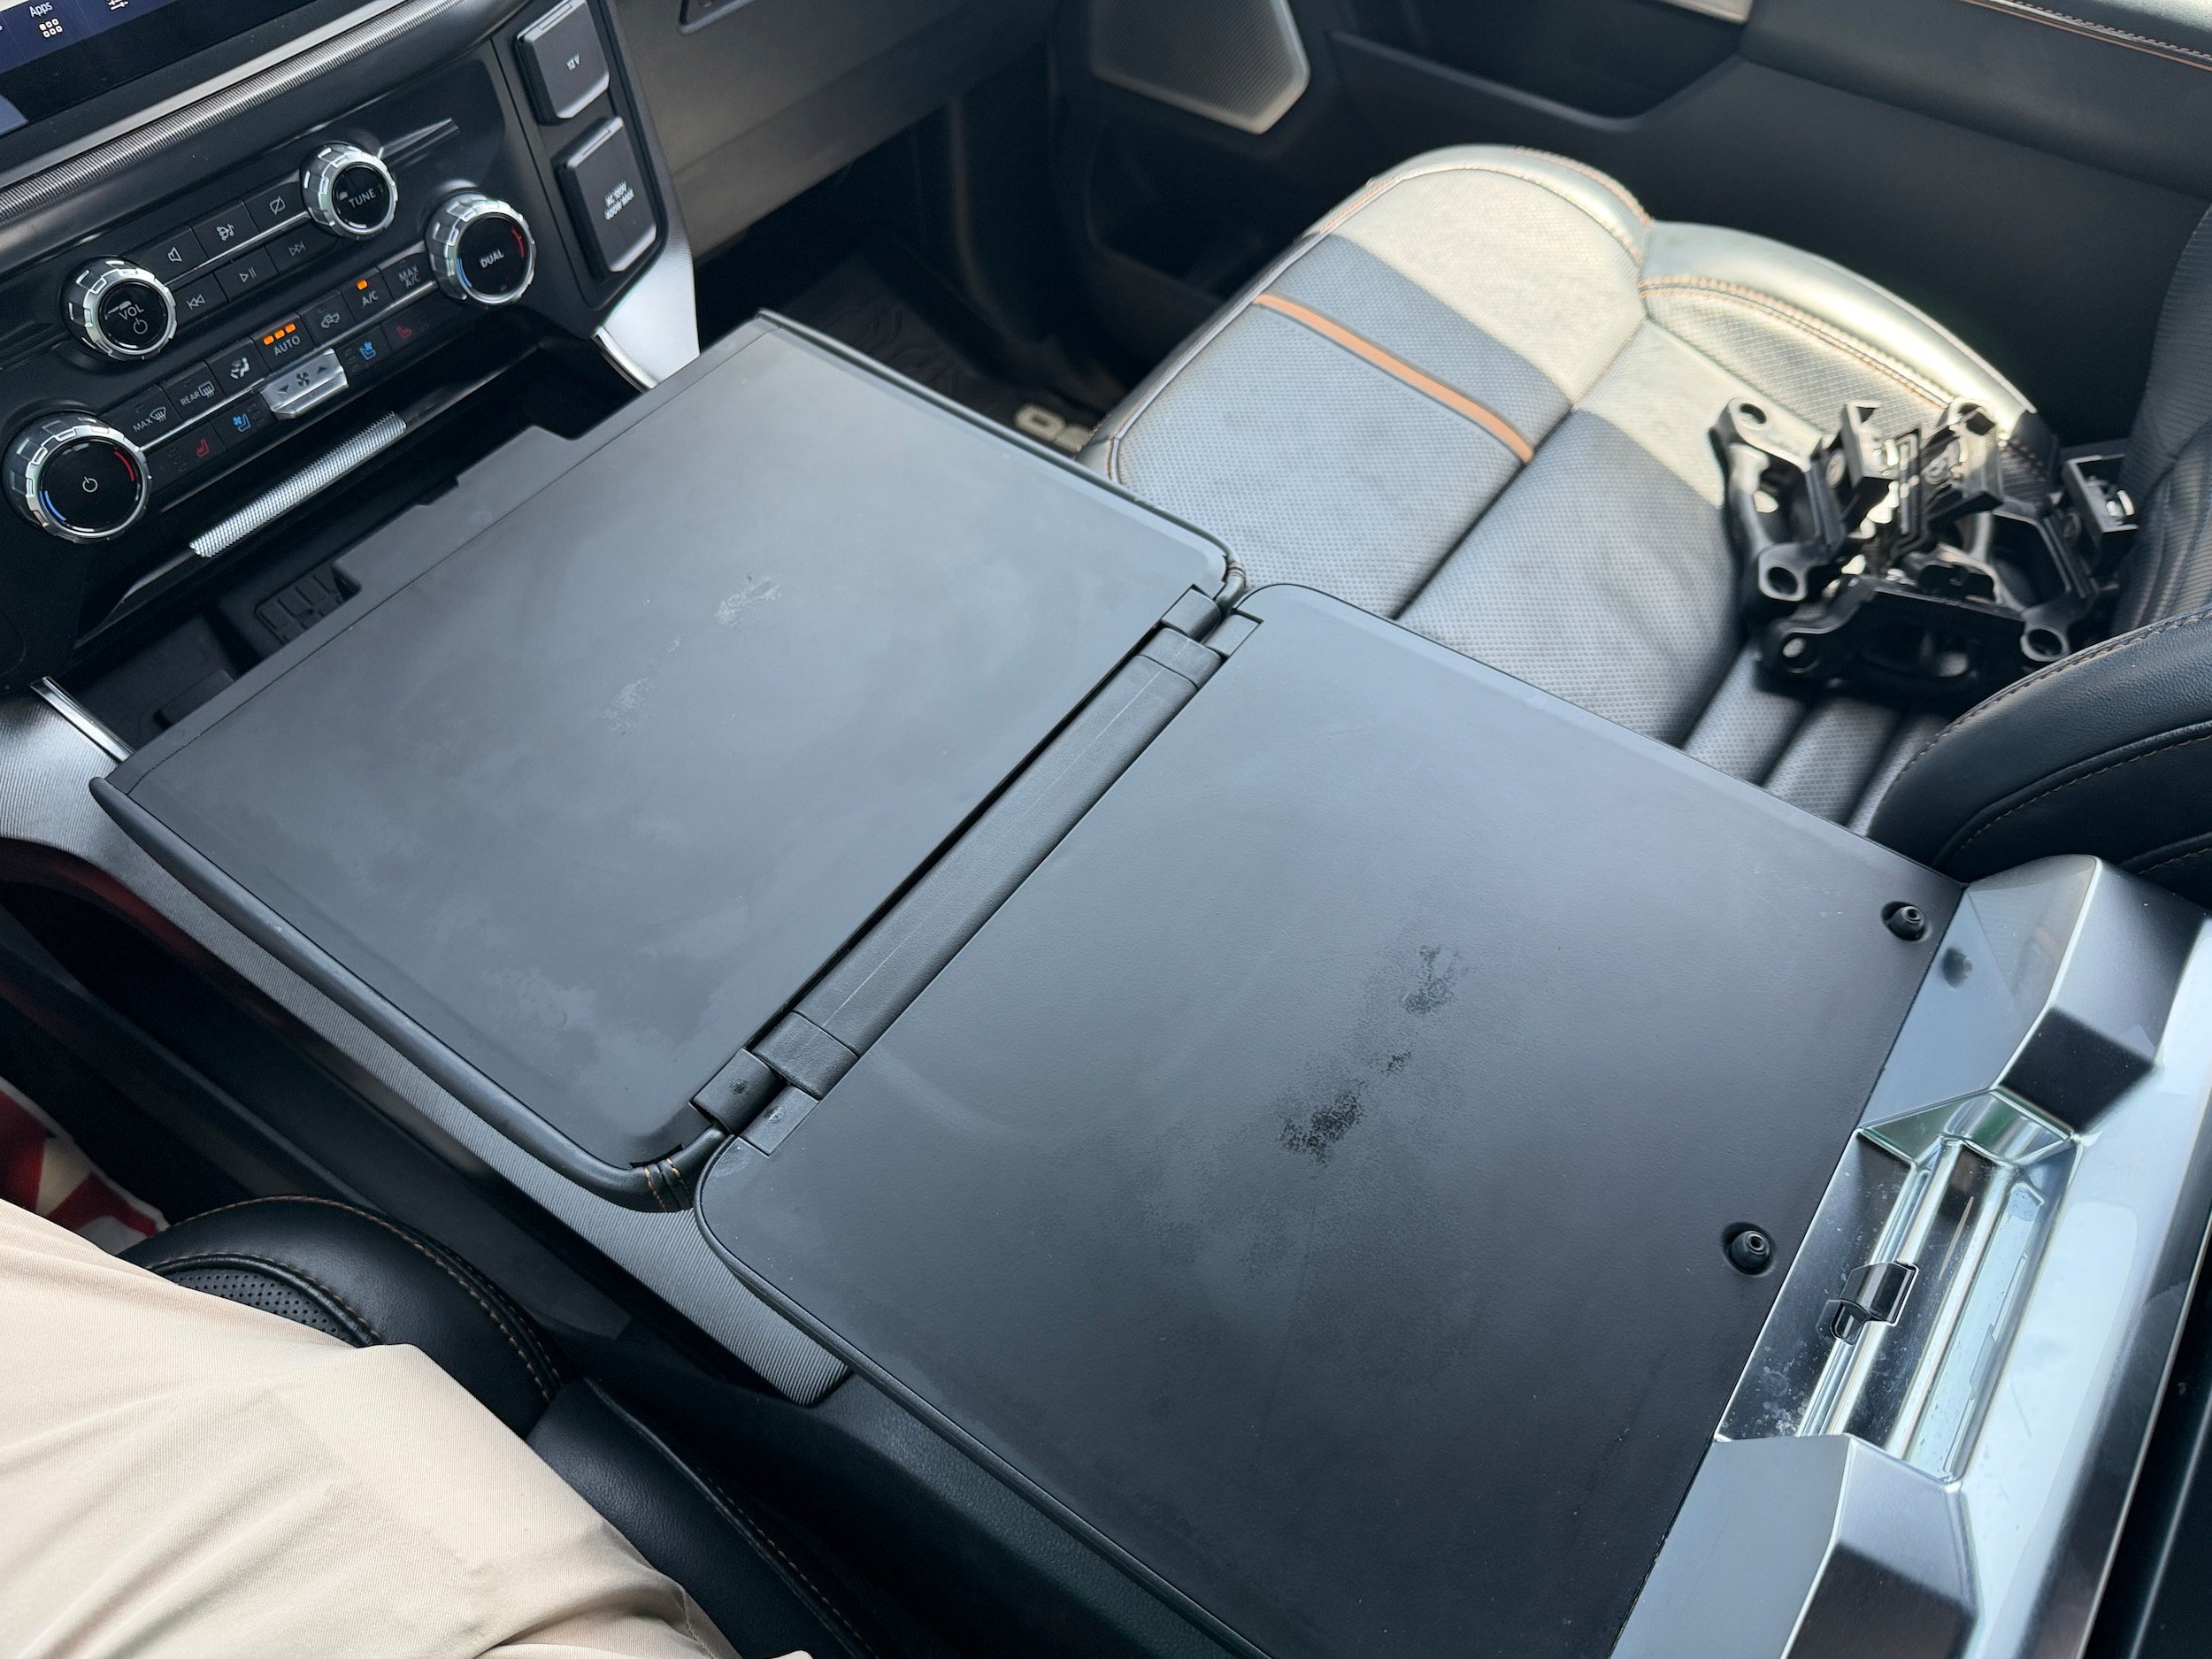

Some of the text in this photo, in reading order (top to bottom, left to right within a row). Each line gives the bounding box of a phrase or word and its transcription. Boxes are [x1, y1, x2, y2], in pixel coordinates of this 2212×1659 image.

[29, 2, 53, 18] Apps
[349, 188, 376, 209] TUNE
[480, 249, 505, 269] DUAL
[361, 290, 380, 307] A/C
[118, 304, 145, 320] VOL
[273, 336, 300, 356] AUTO
[180, 391, 200, 406] REAR
[134, 418, 153, 433] MAX
